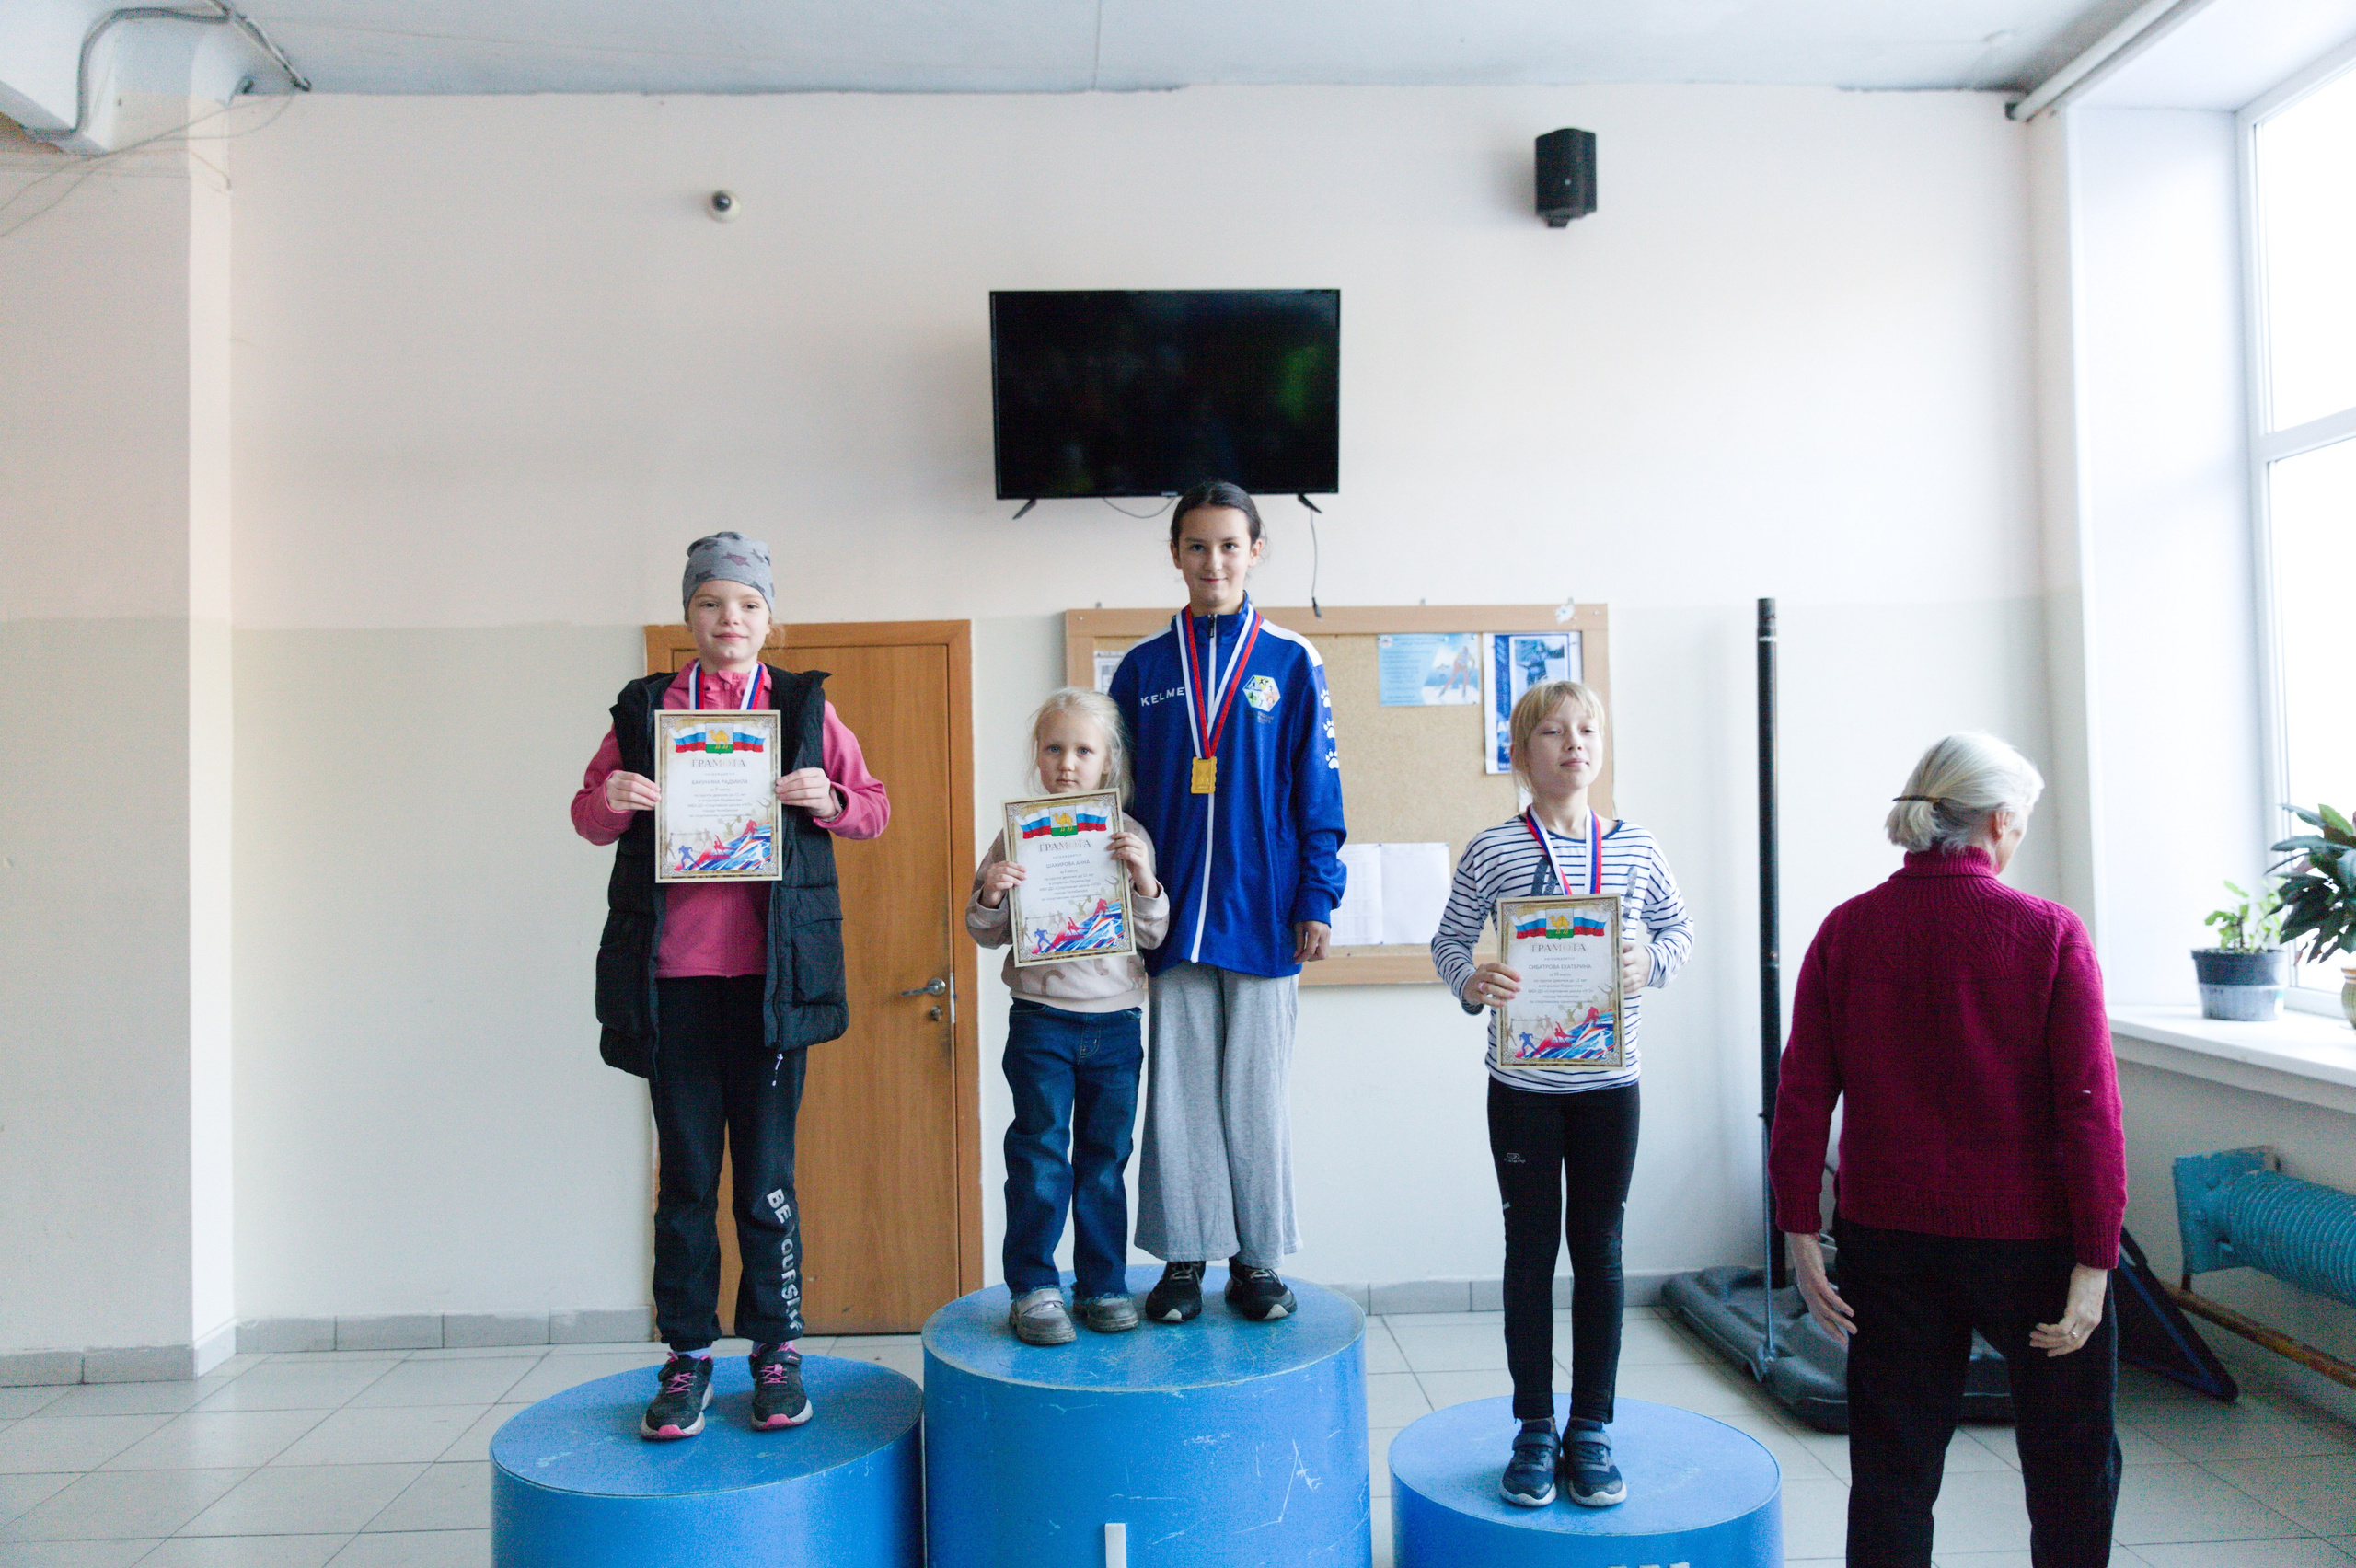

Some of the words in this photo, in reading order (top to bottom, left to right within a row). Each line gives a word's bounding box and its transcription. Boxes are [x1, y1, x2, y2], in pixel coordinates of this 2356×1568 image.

[1140, 686, 1185, 707] KELME
[692, 759, 746, 767] ГРАМОТА
[1039, 839, 1091, 852] ГРАМОТА
[1045, 860, 1075, 869] ШАКИРОВА
[1531, 943, 1587, 952] ГРАМОТА
[767, 1188, 791, 1225] BE
